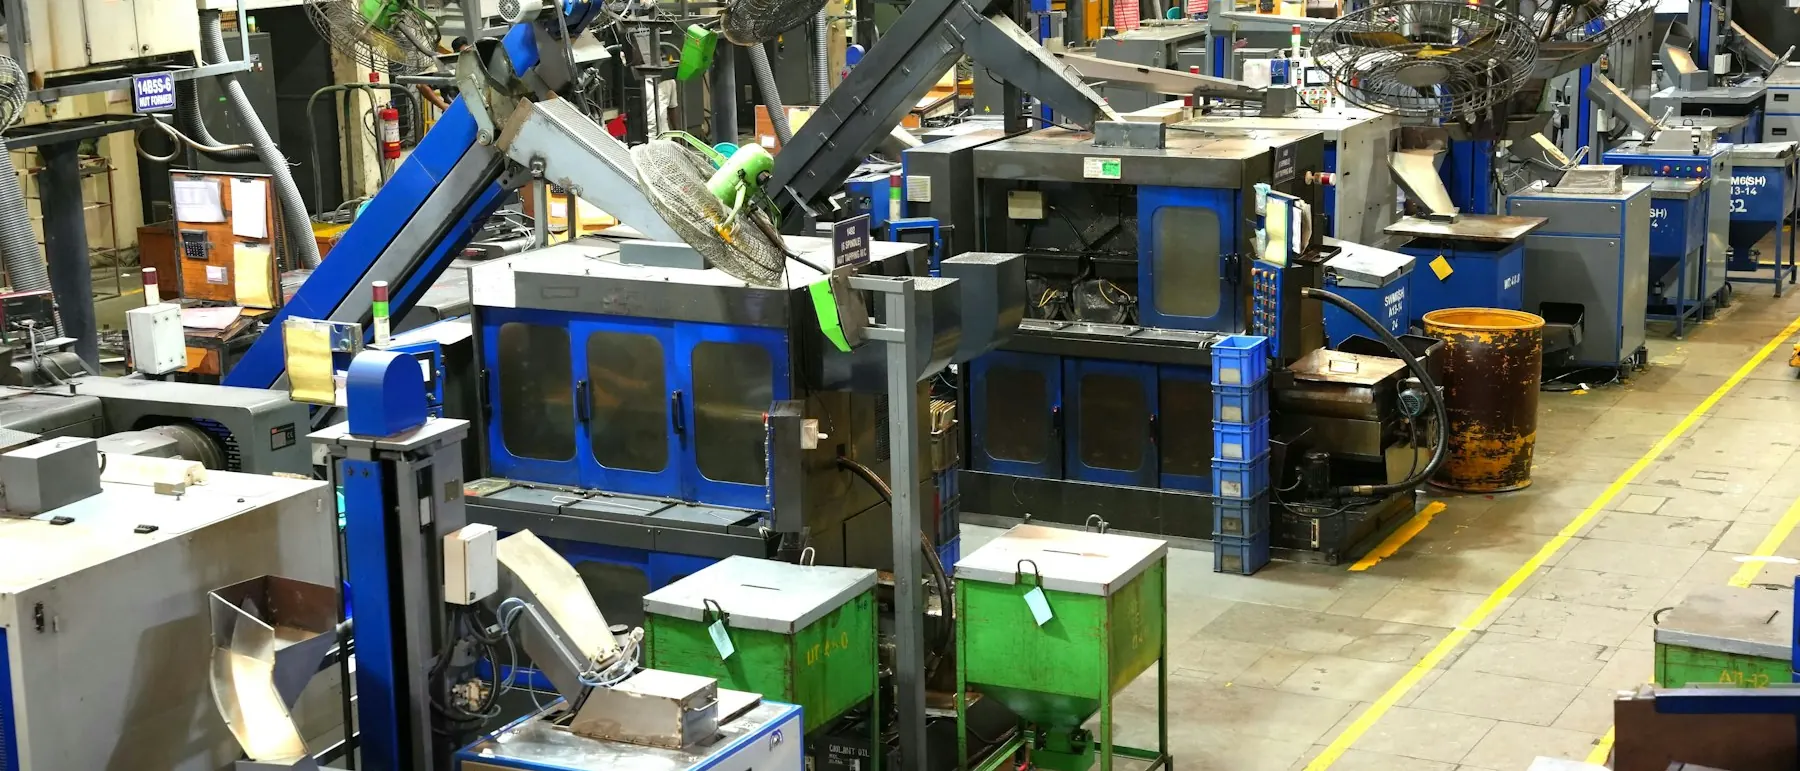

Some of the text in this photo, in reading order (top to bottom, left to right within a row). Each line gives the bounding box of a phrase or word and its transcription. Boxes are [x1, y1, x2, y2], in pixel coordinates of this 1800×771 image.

[138, 77, 171, 95] 14B5S-6
[140, 94, 172, 107] NUT FORMER
[1731, 176, 1766, 187] M6(SH)
[1731, 187, 1757, 196] 13-14
[1650, 208, 1667, 219] SH)
[1651, 219, 1659, 228] 4
